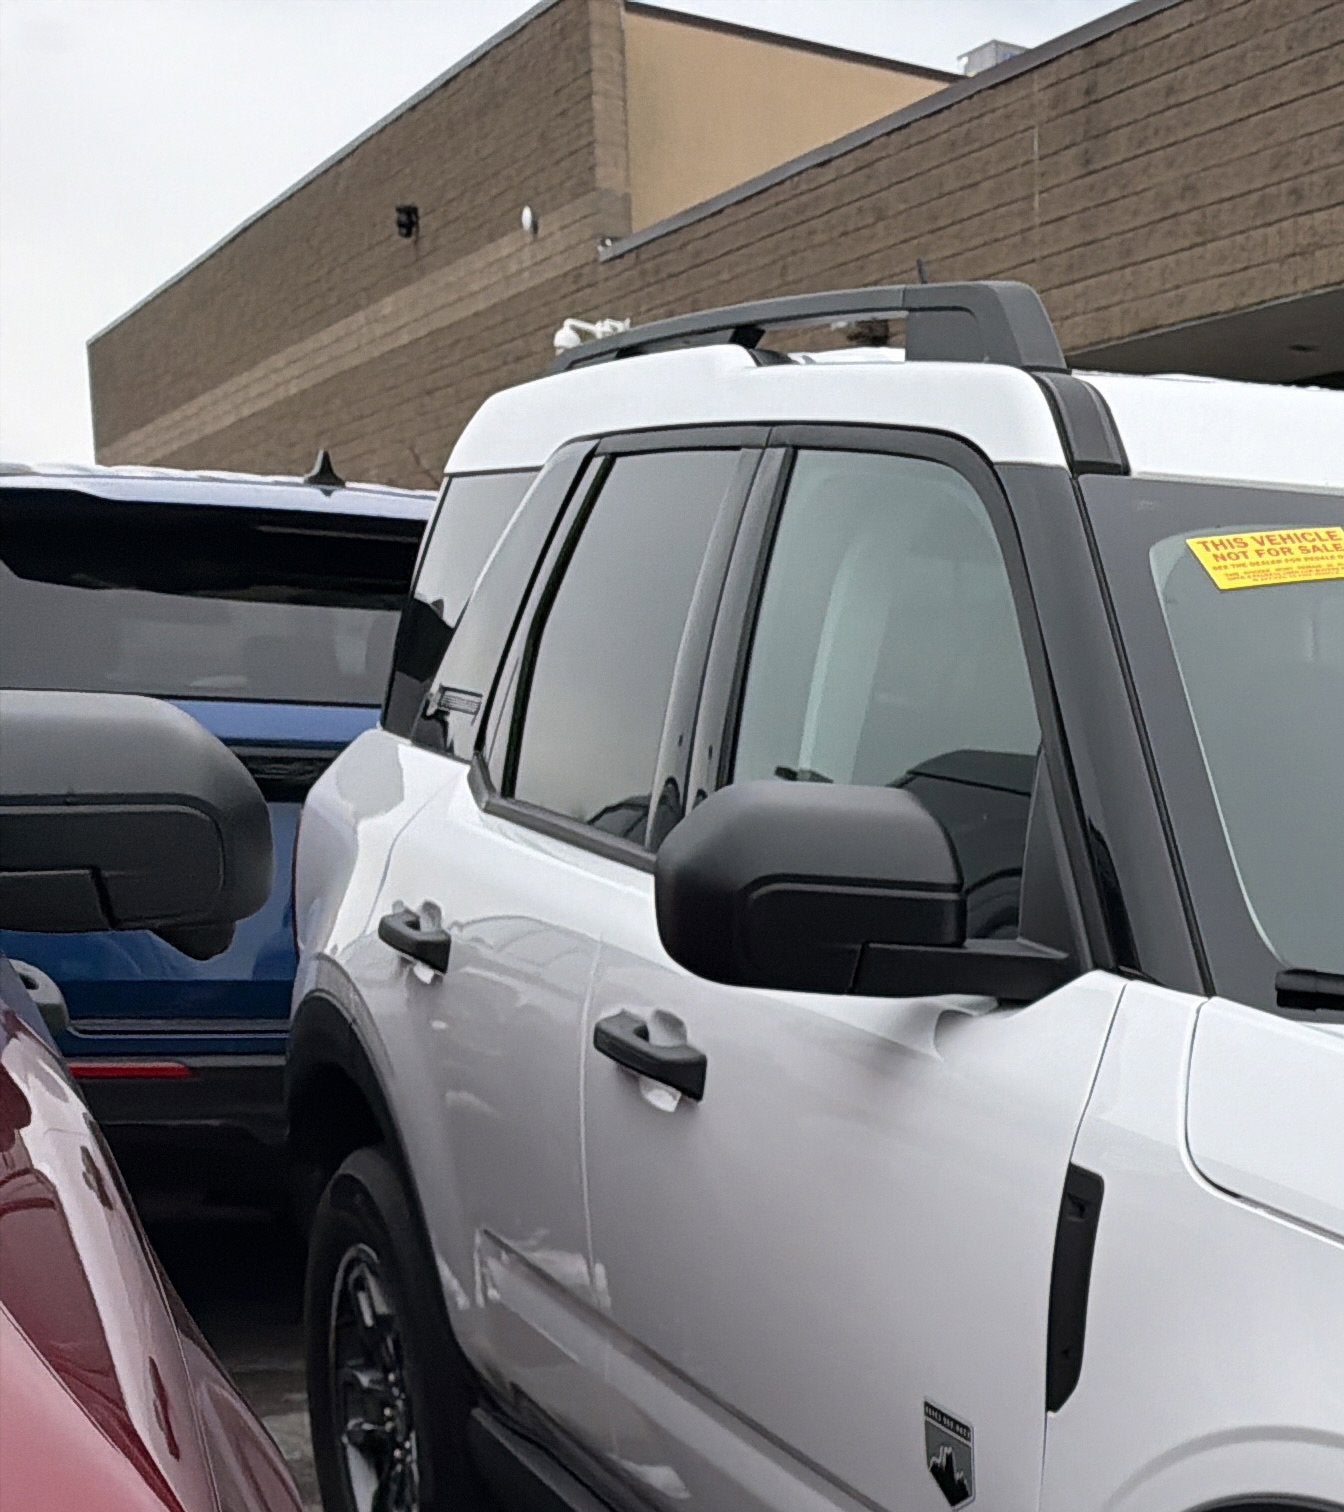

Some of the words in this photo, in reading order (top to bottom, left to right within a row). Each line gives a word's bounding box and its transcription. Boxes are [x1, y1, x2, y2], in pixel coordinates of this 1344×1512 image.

[1197, 537, 1249, 553] THIS
[1251, 530, 1342, 547] VEHICLE
[1212, 551, 1250, 563] NOT
[1256, 546, 1294, 558] FOR
[1299, 543, 1344, 554] SALE
